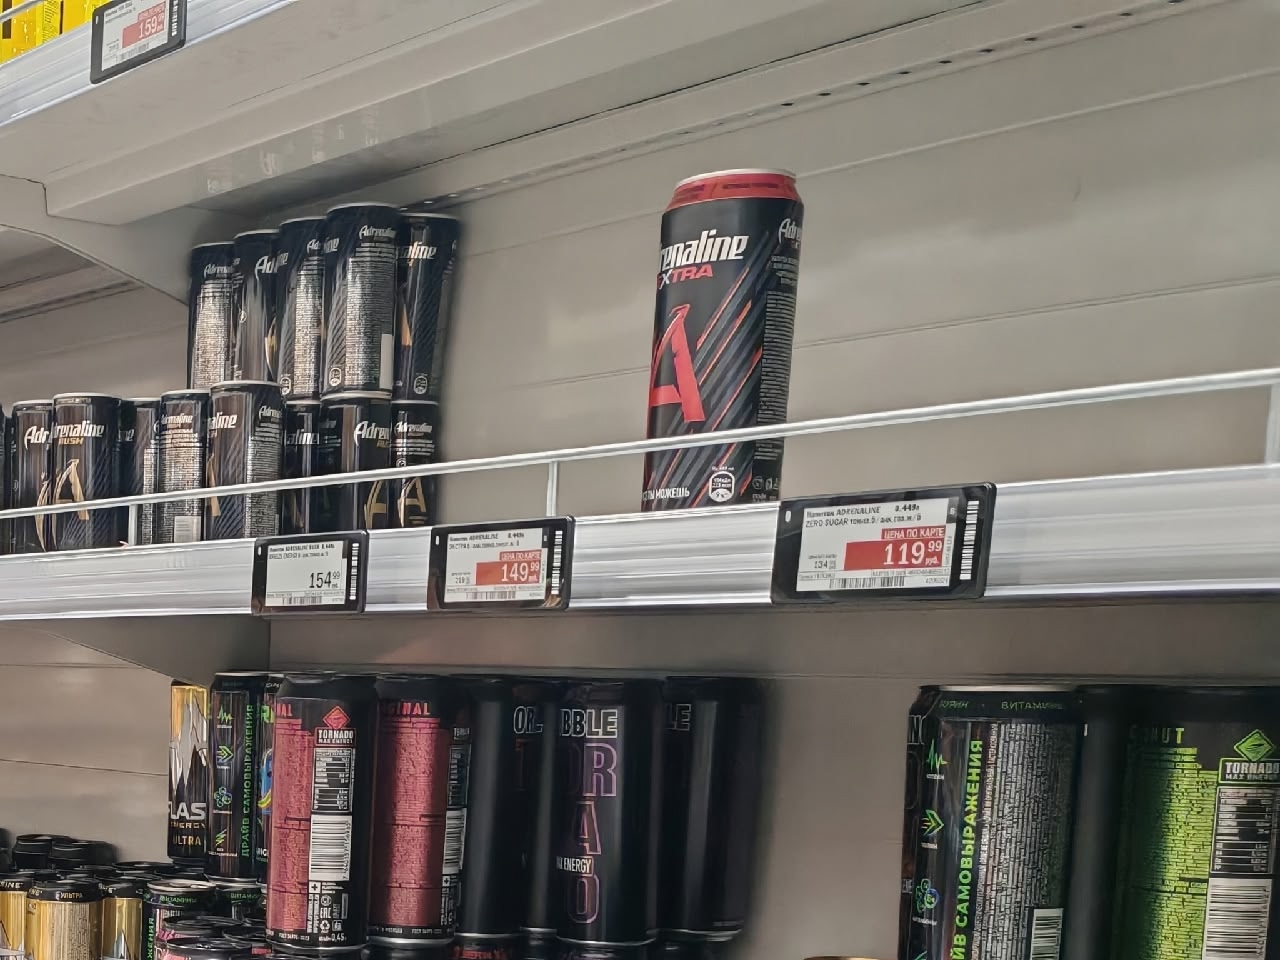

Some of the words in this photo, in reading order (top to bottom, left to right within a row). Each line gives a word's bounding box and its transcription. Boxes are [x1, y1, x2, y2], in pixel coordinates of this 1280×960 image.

[138, 16, 157, 39] 159
[655, 487, 690, 499] МОЖЕШЬ
[836, 506, 880, 516] ADRENALINE
[805, 519, 824, 528] ZERO
[825, 517, 849, 527] SUGAR
[884, 529, 904, 539] ЦЕНА
[906, 528, 918, 538] ПО
[919, 527, 945, 538] КАРТЕ
[883, 541, 925, 566] 119
[928, 540, 943, 552] 99
[501, 562, 528, 582] 149
[530, 561, 540, 572] 99
[309, 571, 332, 589] 154
[317, 729, 354, 739] TORNADO
[956, 740, 983, 929] САМОВЫРАЖЕНИЯ
